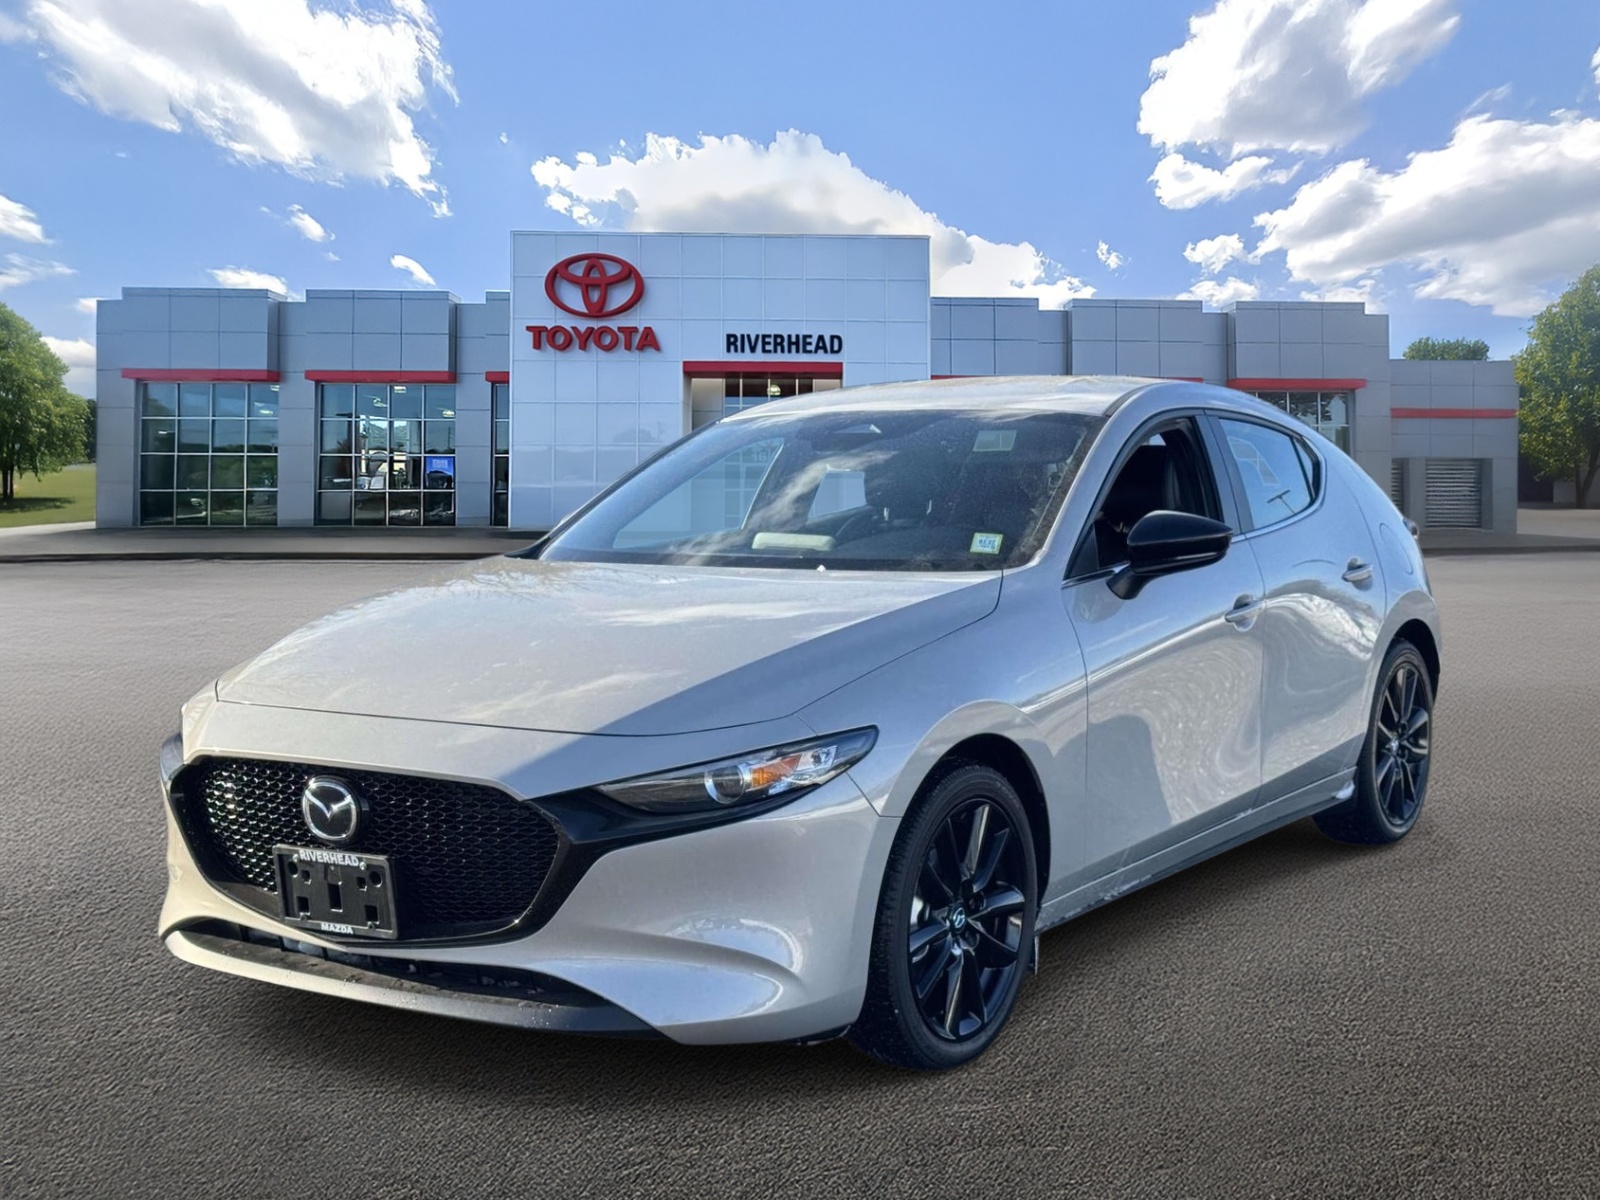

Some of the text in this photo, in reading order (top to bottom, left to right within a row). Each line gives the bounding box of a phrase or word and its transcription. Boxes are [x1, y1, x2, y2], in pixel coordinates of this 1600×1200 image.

[526, 325, 661, 351] TOYOTA
[726, 333, 843, 354] RIVERHEAD
[299, 849, 359, 867] RIVERHEAD
[321, 922, 354, 934] MAZDA
